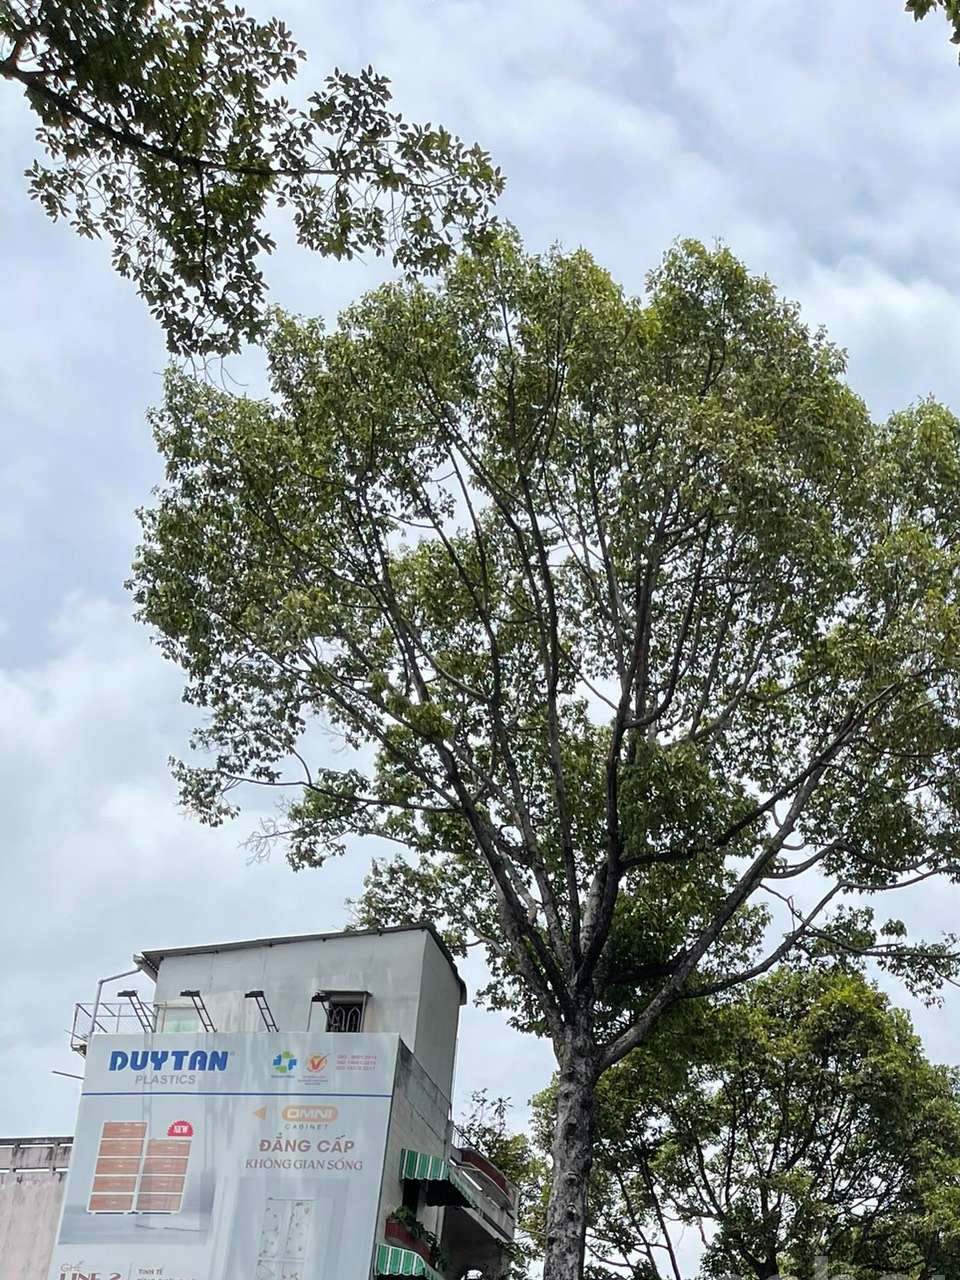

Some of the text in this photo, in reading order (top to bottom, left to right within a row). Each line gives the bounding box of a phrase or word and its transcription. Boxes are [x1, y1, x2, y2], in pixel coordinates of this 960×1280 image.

[135, 1074, 197, 1085] PLASTICS
[286, 1108, 333, 1119] OMNI
[316, 1134, 355, 1153] CẤP
[245, 1157, 292, 1170] KHÔNG
[293, 1159, 326, 1170] GIAN
